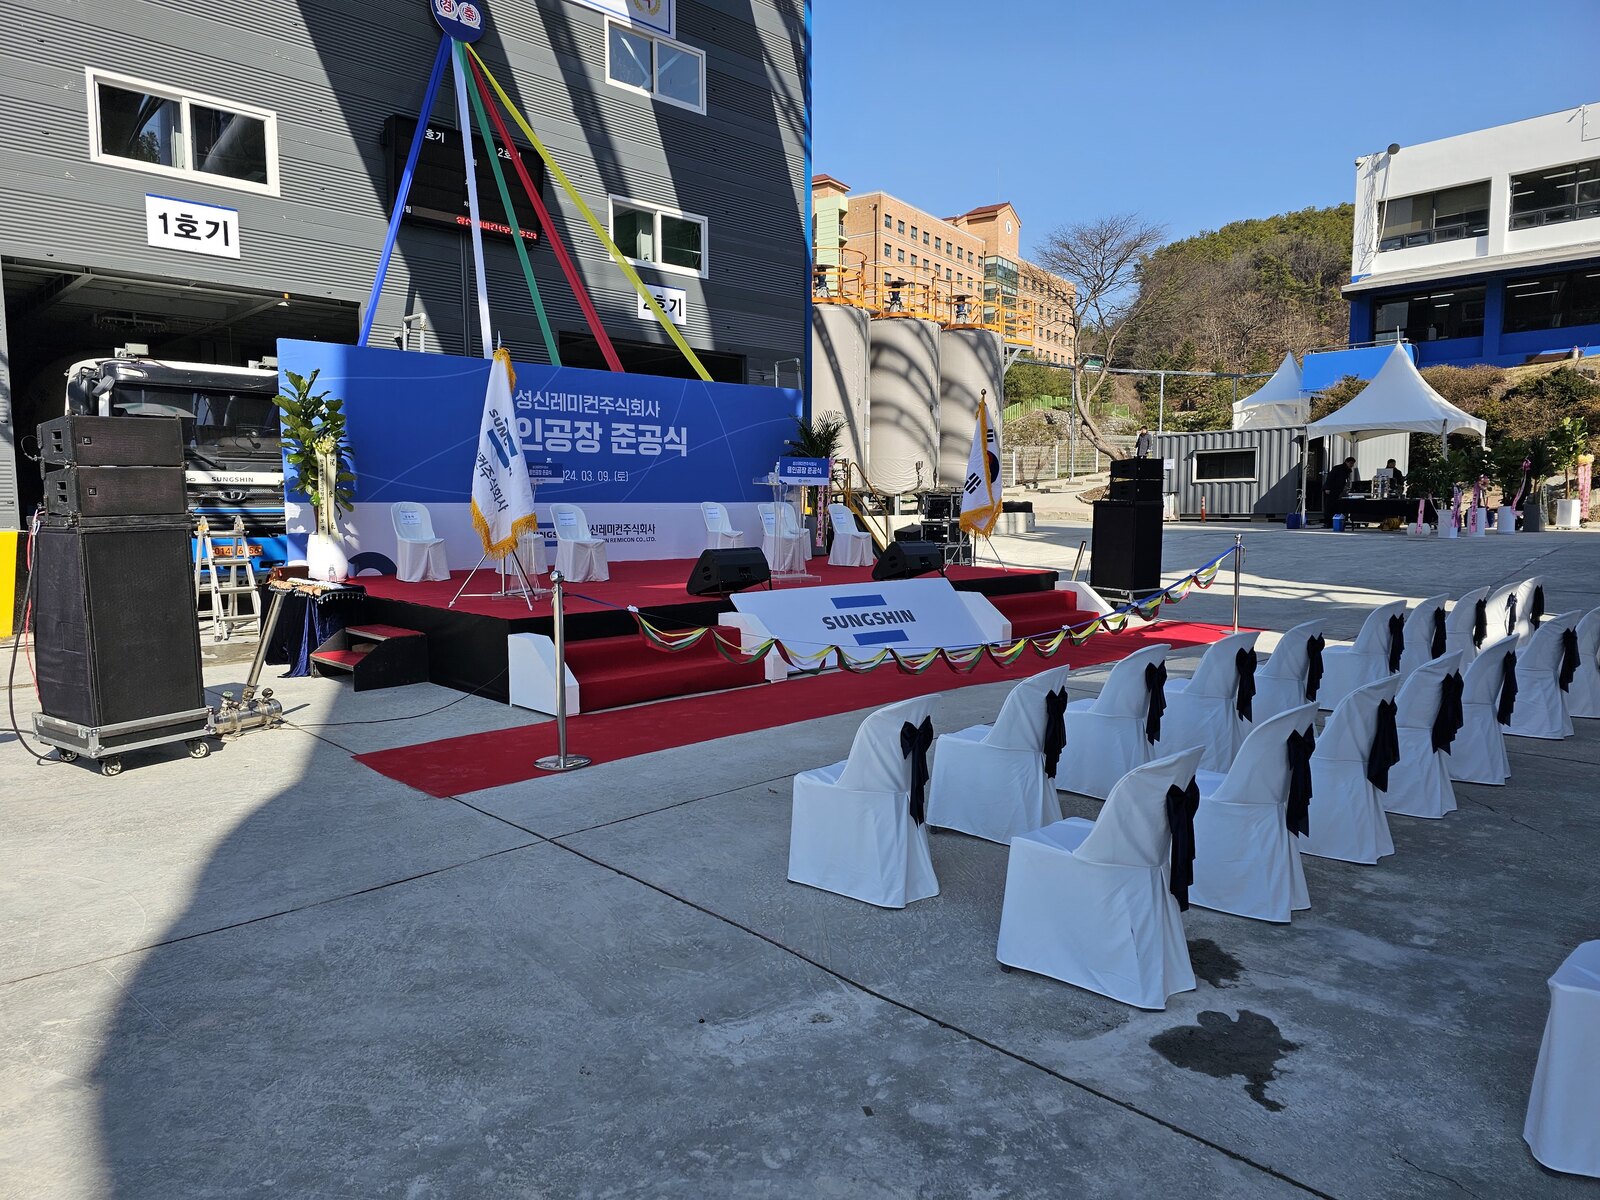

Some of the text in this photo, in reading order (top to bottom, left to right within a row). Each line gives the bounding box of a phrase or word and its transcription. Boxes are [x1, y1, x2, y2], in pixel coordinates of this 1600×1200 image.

[158, 212, 229, 247] 1호기
[515, 389, 660, 418] 성신레미컨주식회사
[611, 422, 688, 457] 준공식
[581, 470, 595, 482] 03.
[598, 470, 611, 482] 09.
[587, 523, 656, 536] 신레미컨주식회사
[821, 609, 917, 630] SUNGSHIN
